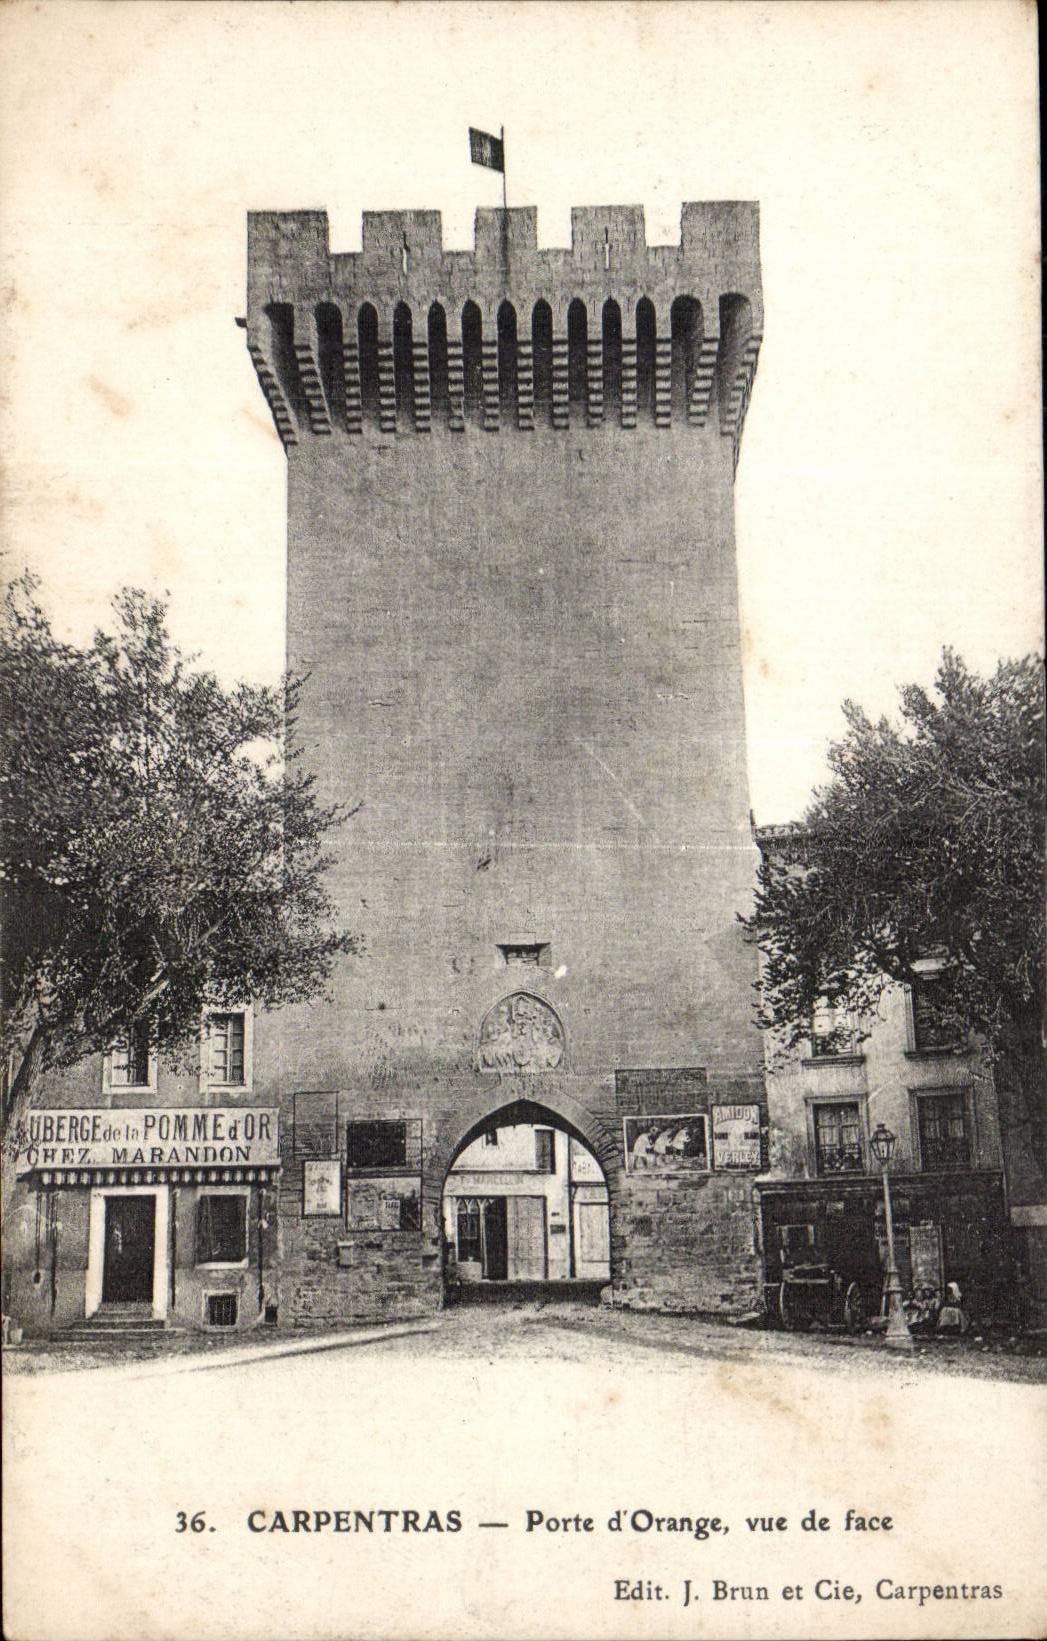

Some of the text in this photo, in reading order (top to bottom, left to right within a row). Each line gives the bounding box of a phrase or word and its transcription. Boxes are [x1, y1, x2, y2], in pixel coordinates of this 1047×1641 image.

[30, 1114, 101, 1143] UBERGE
[103, 1124, 121, 1142] de
[125, 1124, 139, 1140] la
[143, 1113, 225, 1143] POMME
[27, 1145, 252, 1167] CHEZ MARANDON
